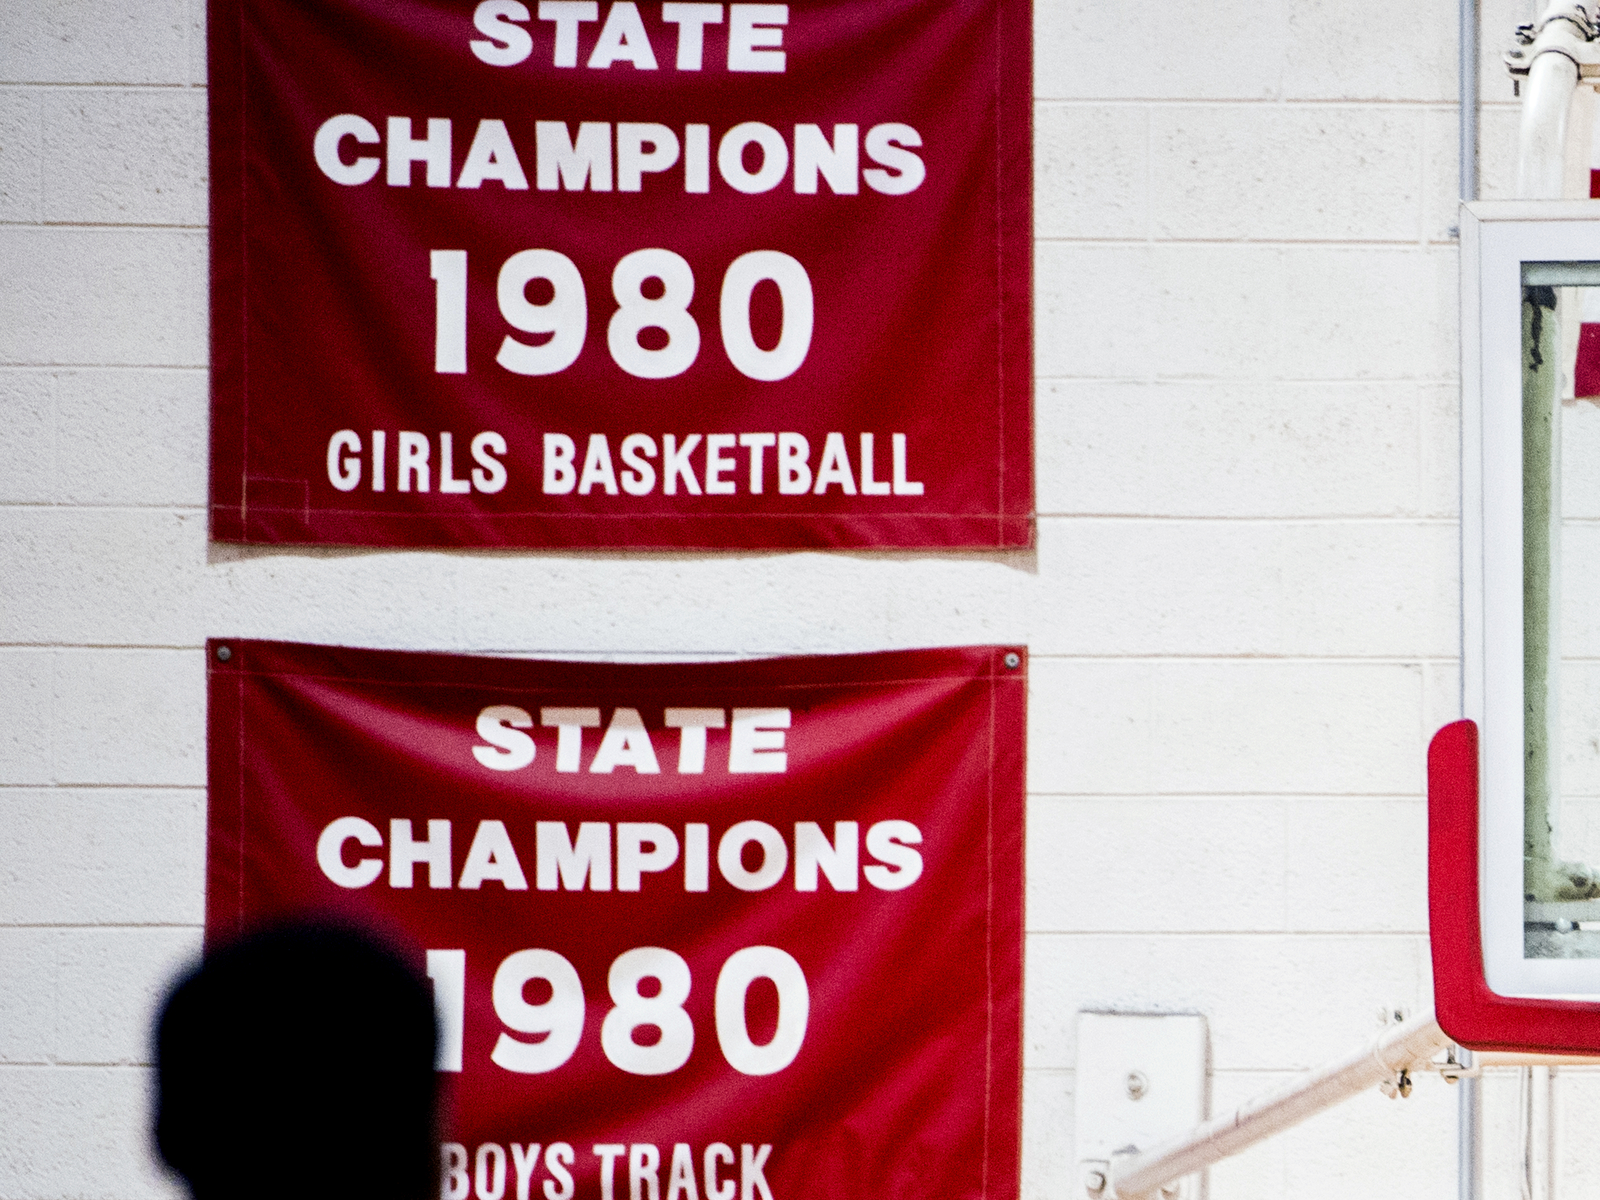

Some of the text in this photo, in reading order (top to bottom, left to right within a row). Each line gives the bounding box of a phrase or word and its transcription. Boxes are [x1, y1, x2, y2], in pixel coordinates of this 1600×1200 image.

[469, 0, 789, 73] STATE
[313, 113, 926, 195] CHAMPIONS
[430, 247, 814, 382] 1980
[327, 429, 925, 496] GIRLS BASKETBALL
[472, 706, 792, 775] STATE
[316, 816, 924, 892] CHAMPIONS
[427, 945, 810, 1076] 1980
